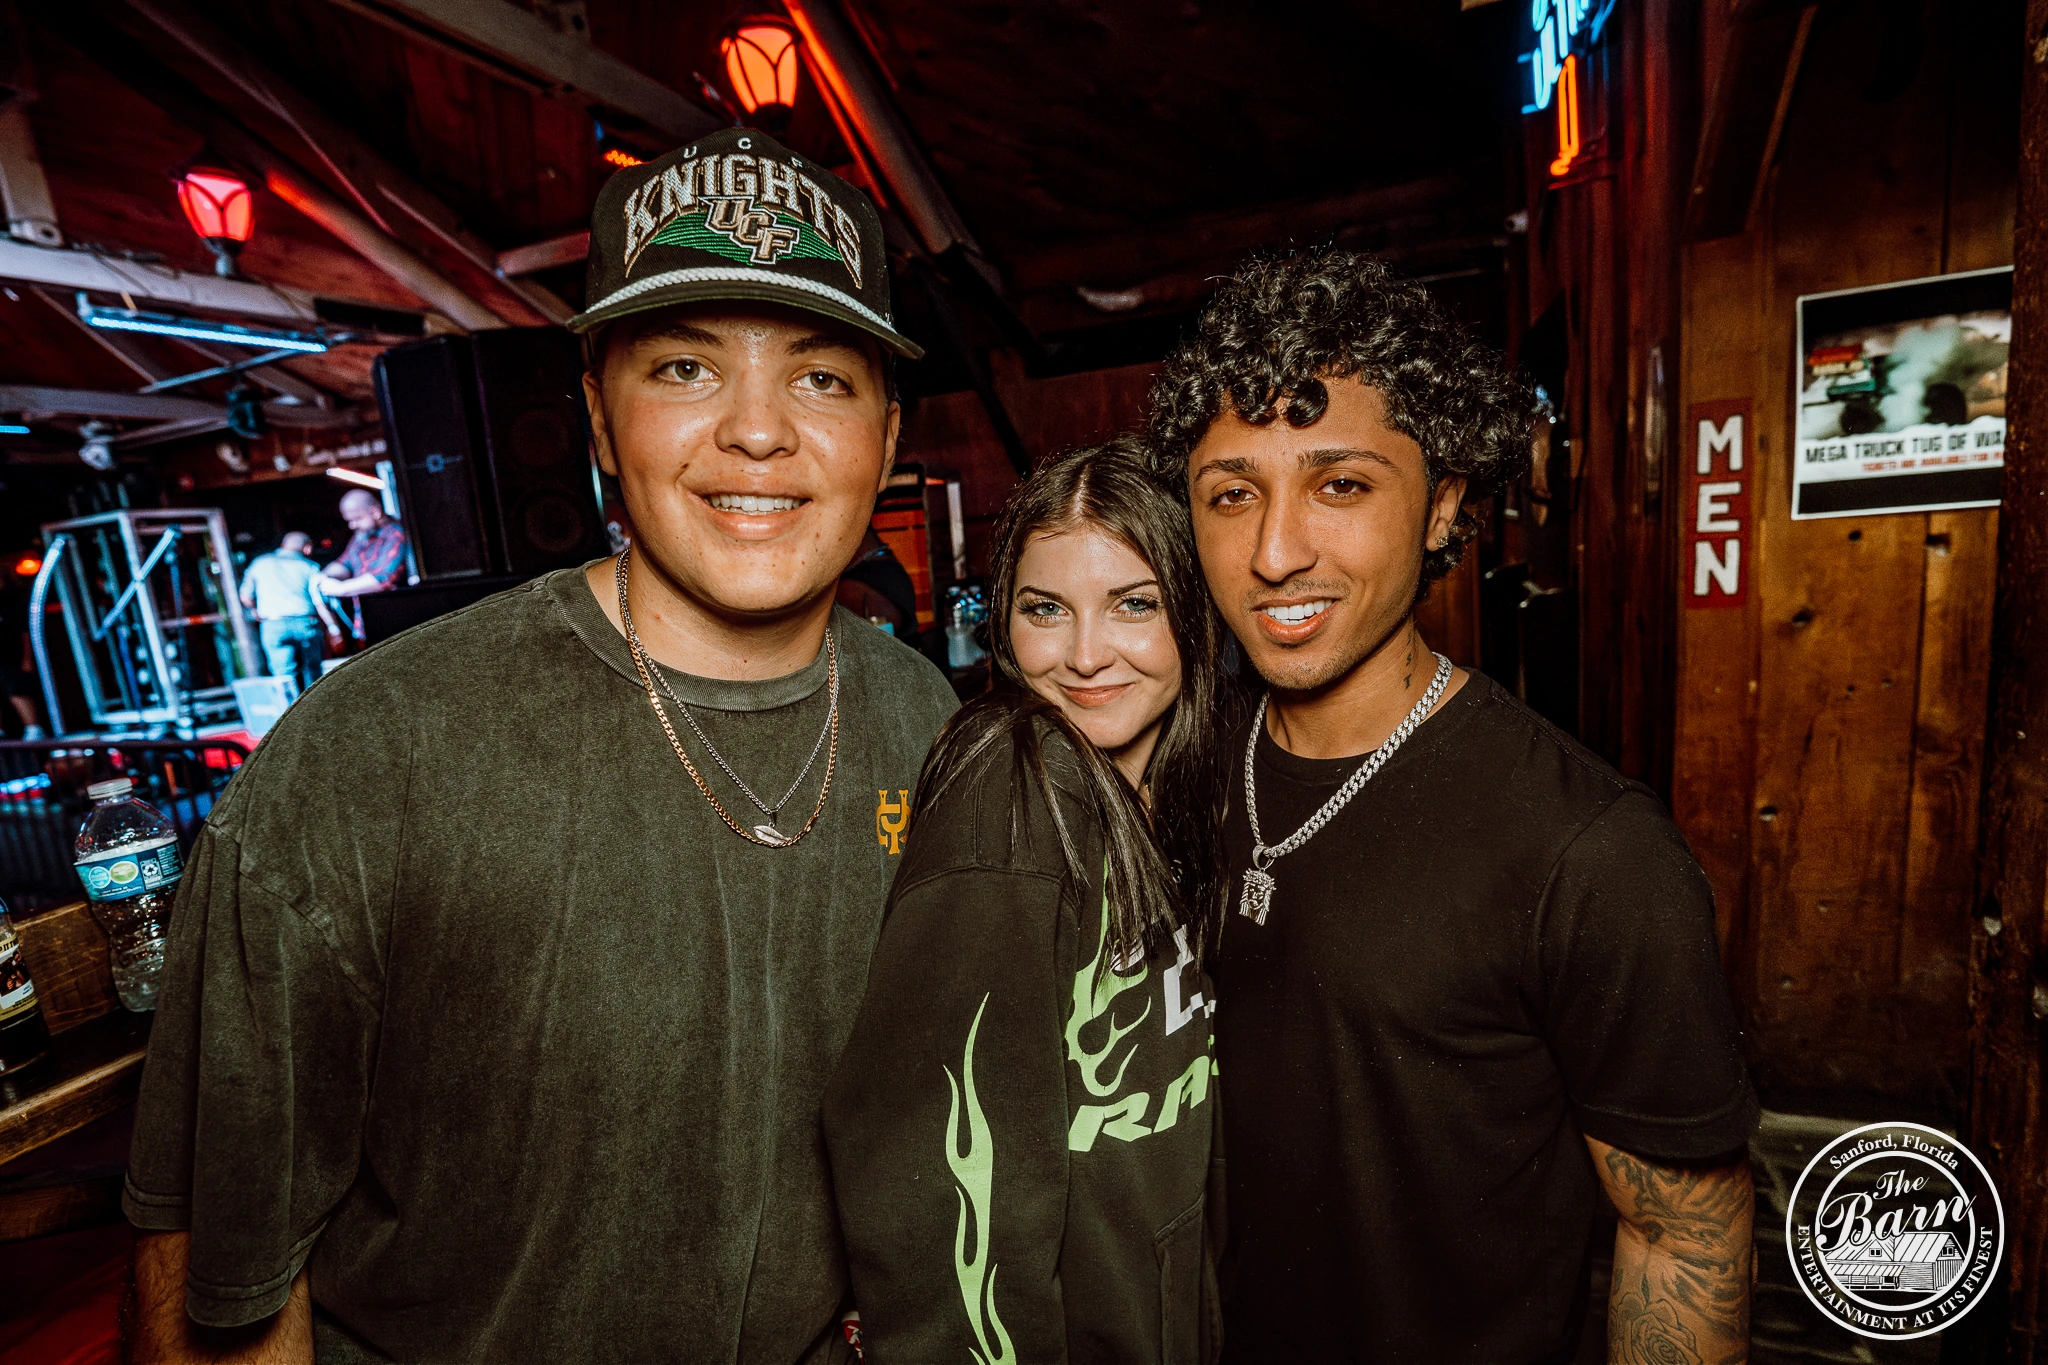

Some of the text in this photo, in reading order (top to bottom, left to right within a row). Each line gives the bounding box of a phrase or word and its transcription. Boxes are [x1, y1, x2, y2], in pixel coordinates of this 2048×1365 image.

[623, 153, 863, 289] KNIGHTS
[698, 195, 800, 265] UCF
[1806, 445, 1848, 463] MEGA
[1855, 440, 1905, 458] TRUCK
[1912, 436, 1943, 453] TUG
[1948, 432, 1967, 450] OF
[1693, 414, 1744, 596] MEN
